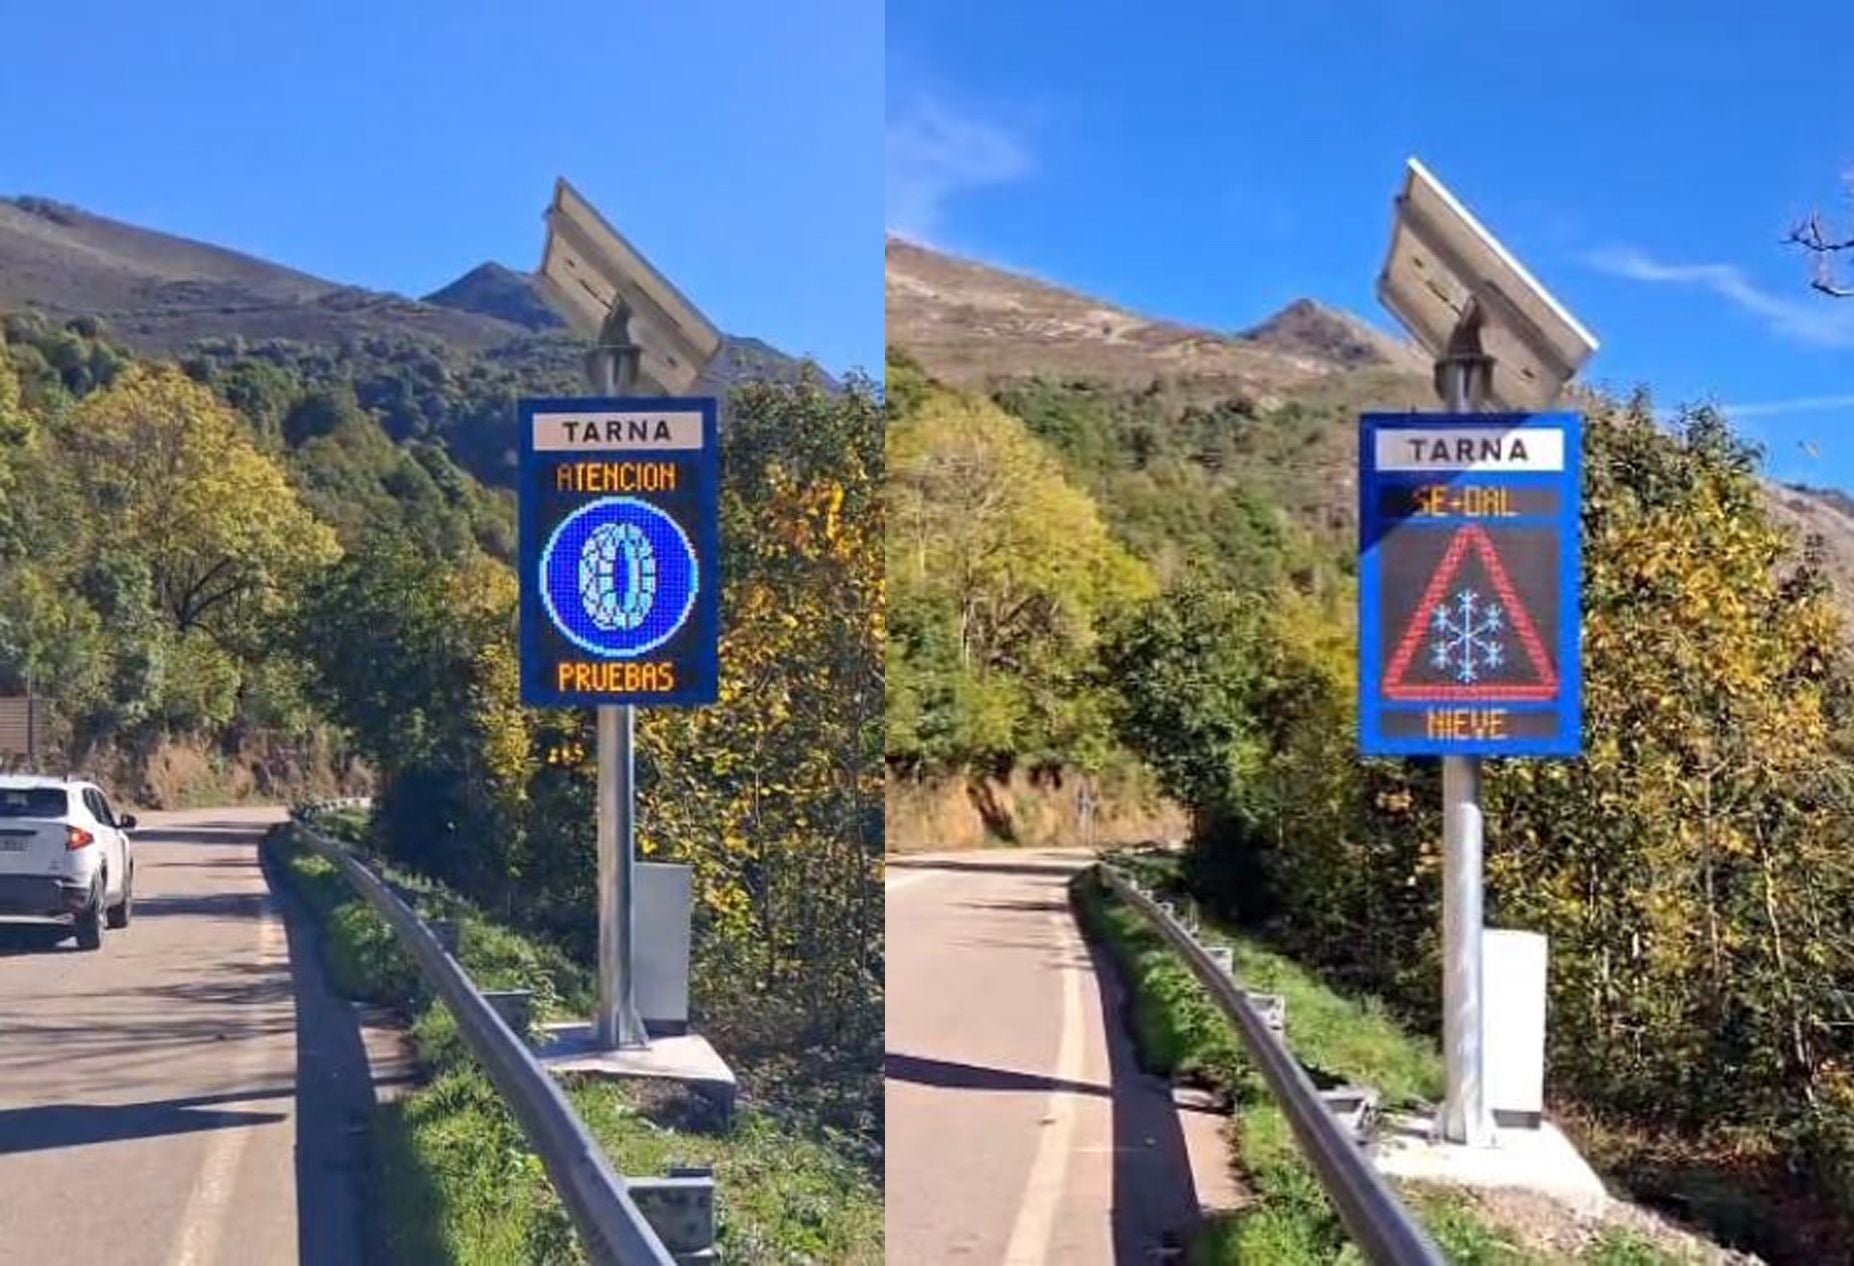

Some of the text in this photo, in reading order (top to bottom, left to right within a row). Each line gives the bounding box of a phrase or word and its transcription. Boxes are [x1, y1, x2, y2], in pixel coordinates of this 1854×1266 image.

[562, 420, 672, 442] TARNA
[1408, 438, 1529, 461] TARNA
[557, 461, 676, 491] ATENCION
[557, 662, 674, 692] PRUEBAS
[1427, 707, 1508, 740] NIEVE
